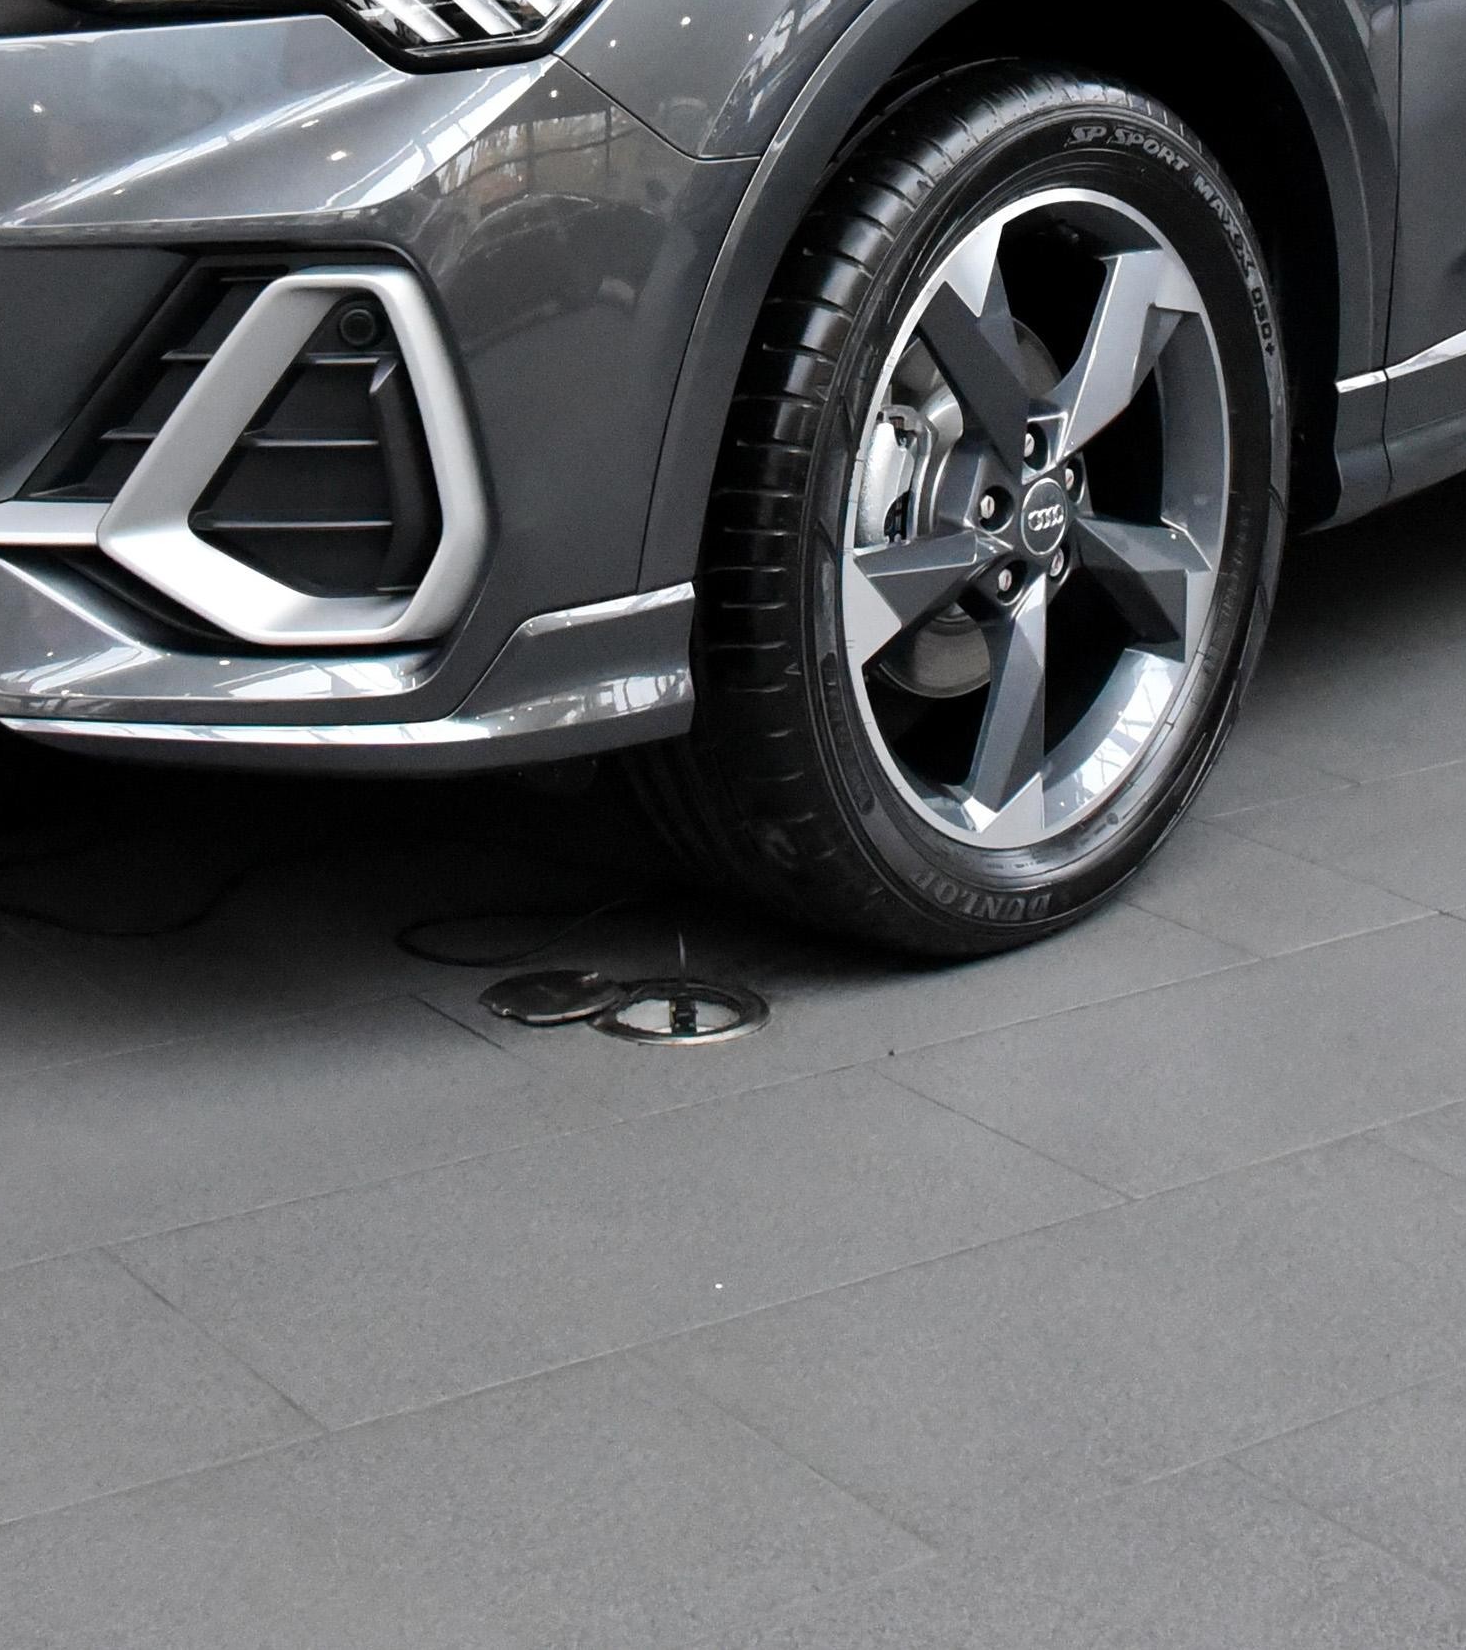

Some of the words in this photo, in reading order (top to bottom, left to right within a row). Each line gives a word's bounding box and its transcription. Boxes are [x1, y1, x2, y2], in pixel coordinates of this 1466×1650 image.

[1064, 124, 1107, 148] SP
[1107, 124, 1190, 172] SPORT
[1193, 172, 1256, 278] MAXX
